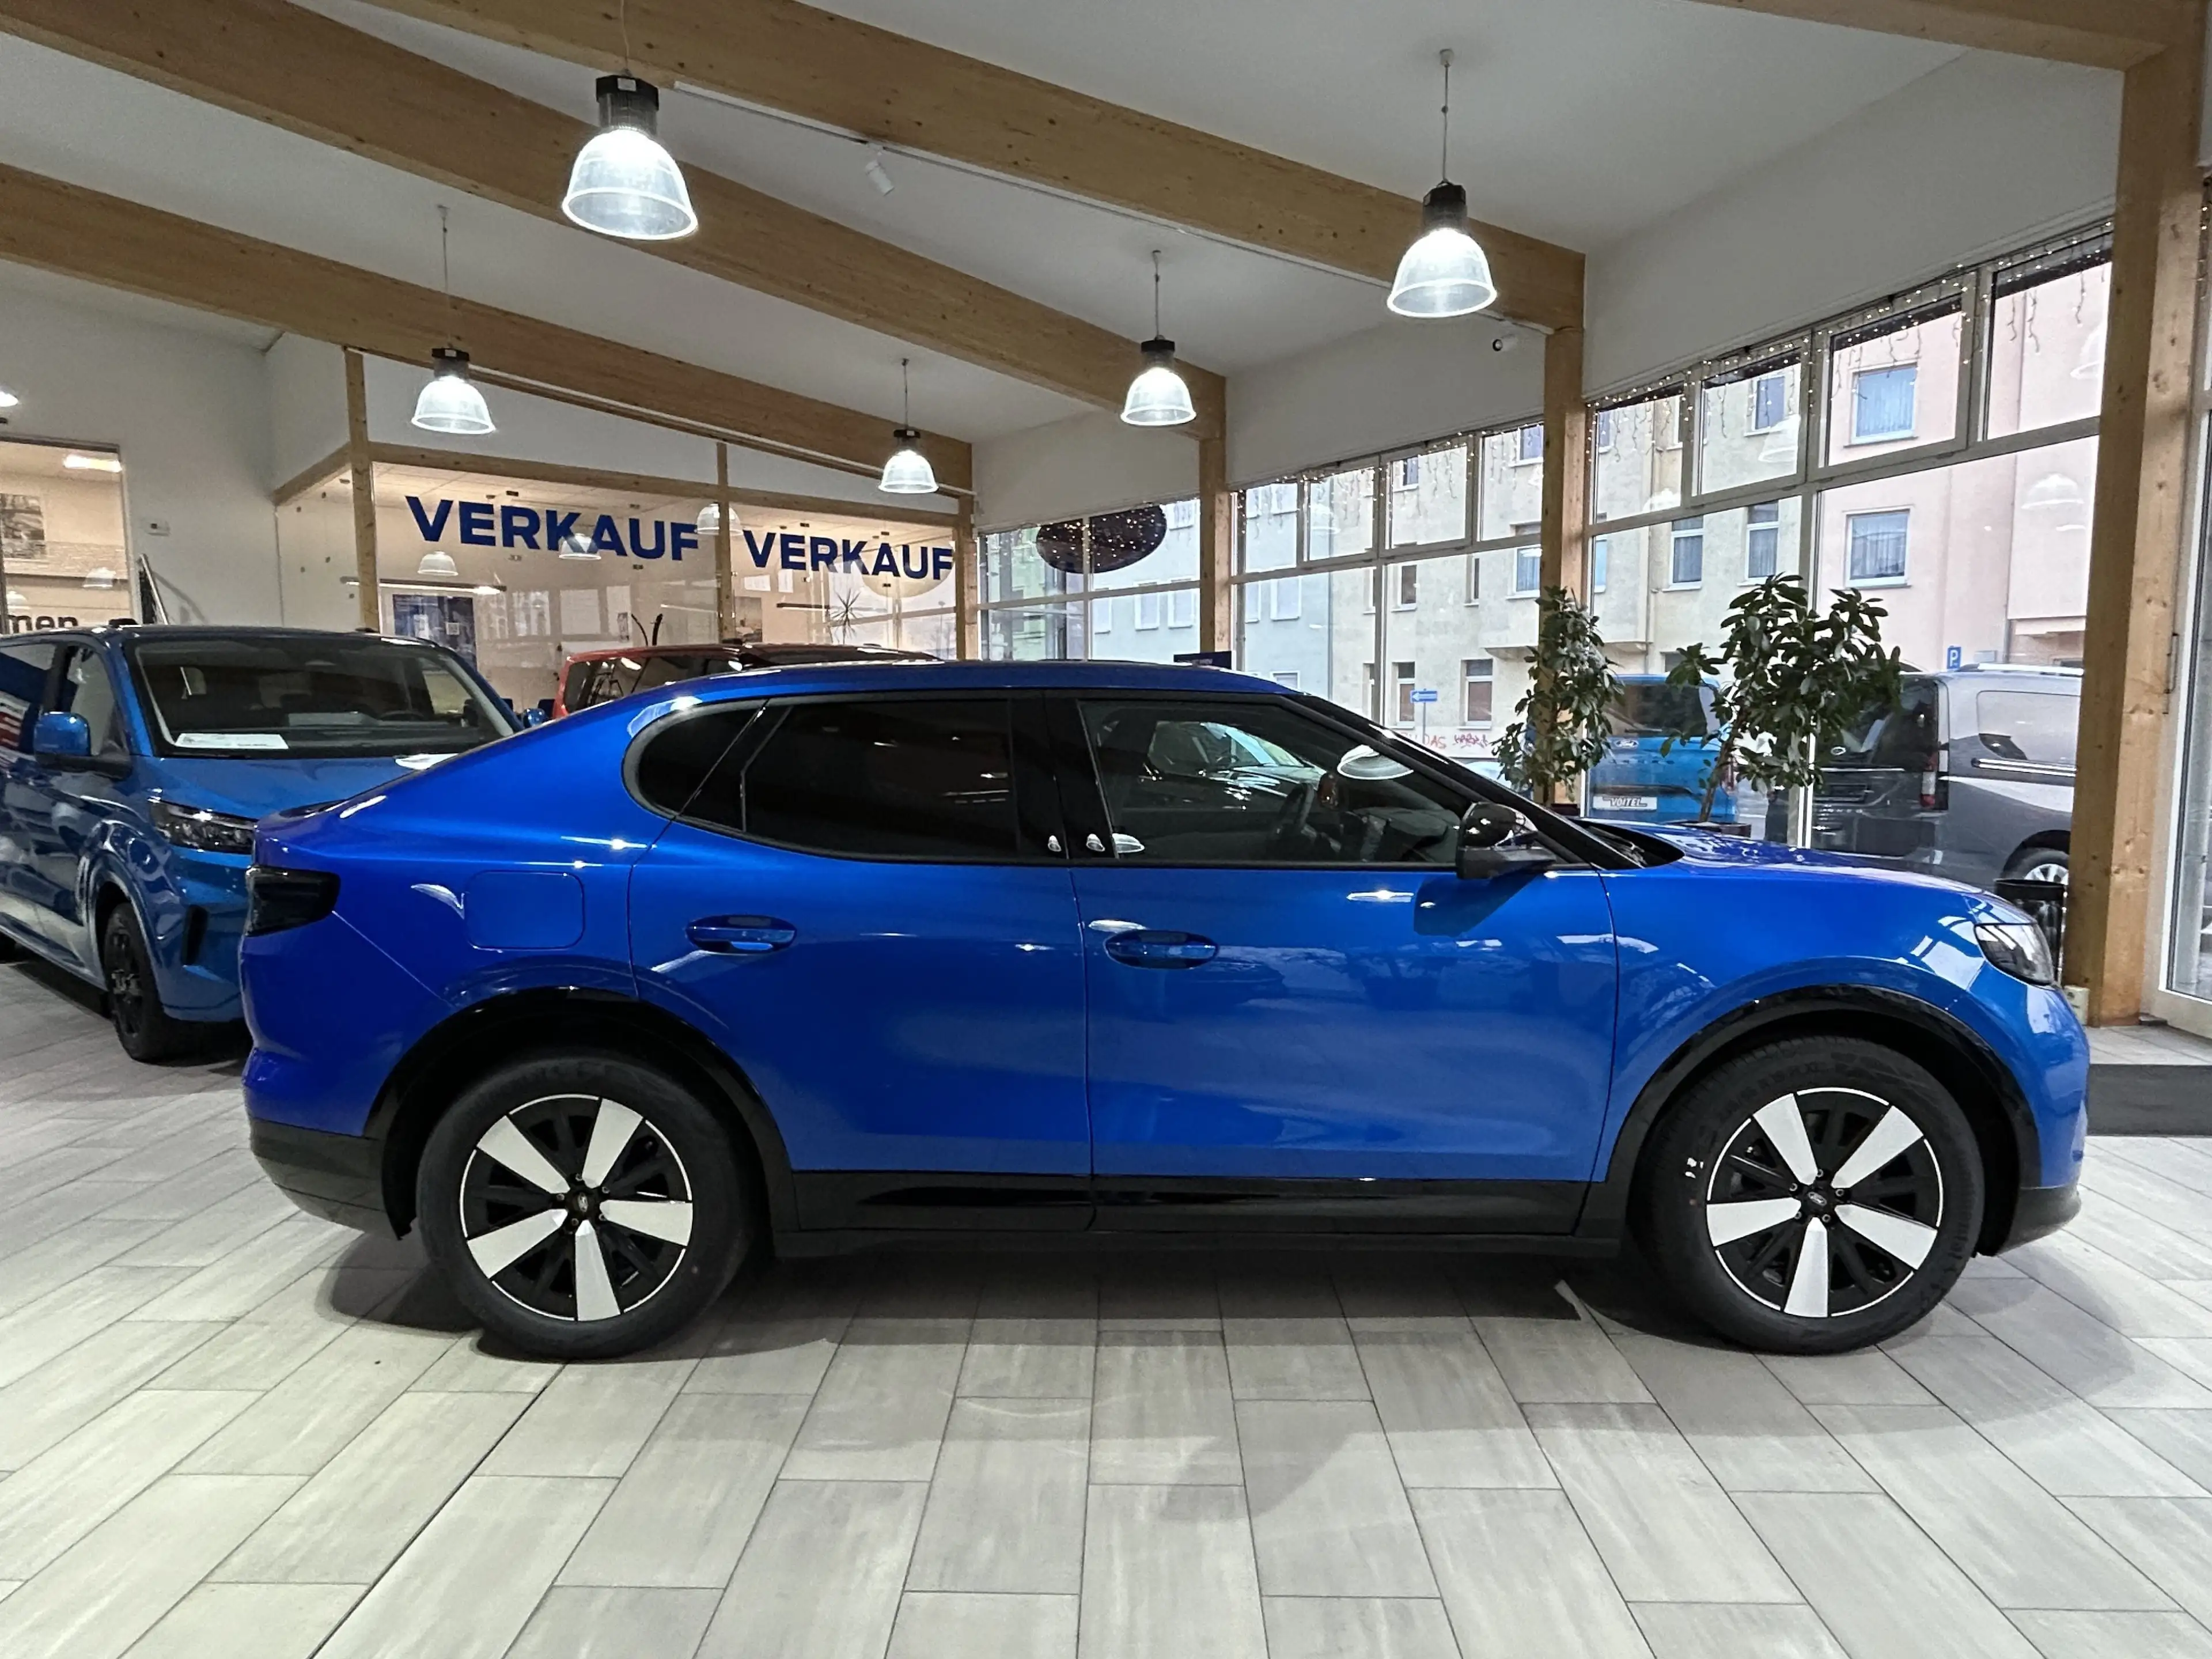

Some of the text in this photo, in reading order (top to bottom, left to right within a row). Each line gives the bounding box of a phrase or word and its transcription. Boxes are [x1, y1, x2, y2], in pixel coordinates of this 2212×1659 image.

[405, 496, 699, 561] VERKAUF
[742, 529, 954, 581] VERKAUF
[1950, 650, 1959, 667] P
[1611, 797, 1641, 806] VOITEL
